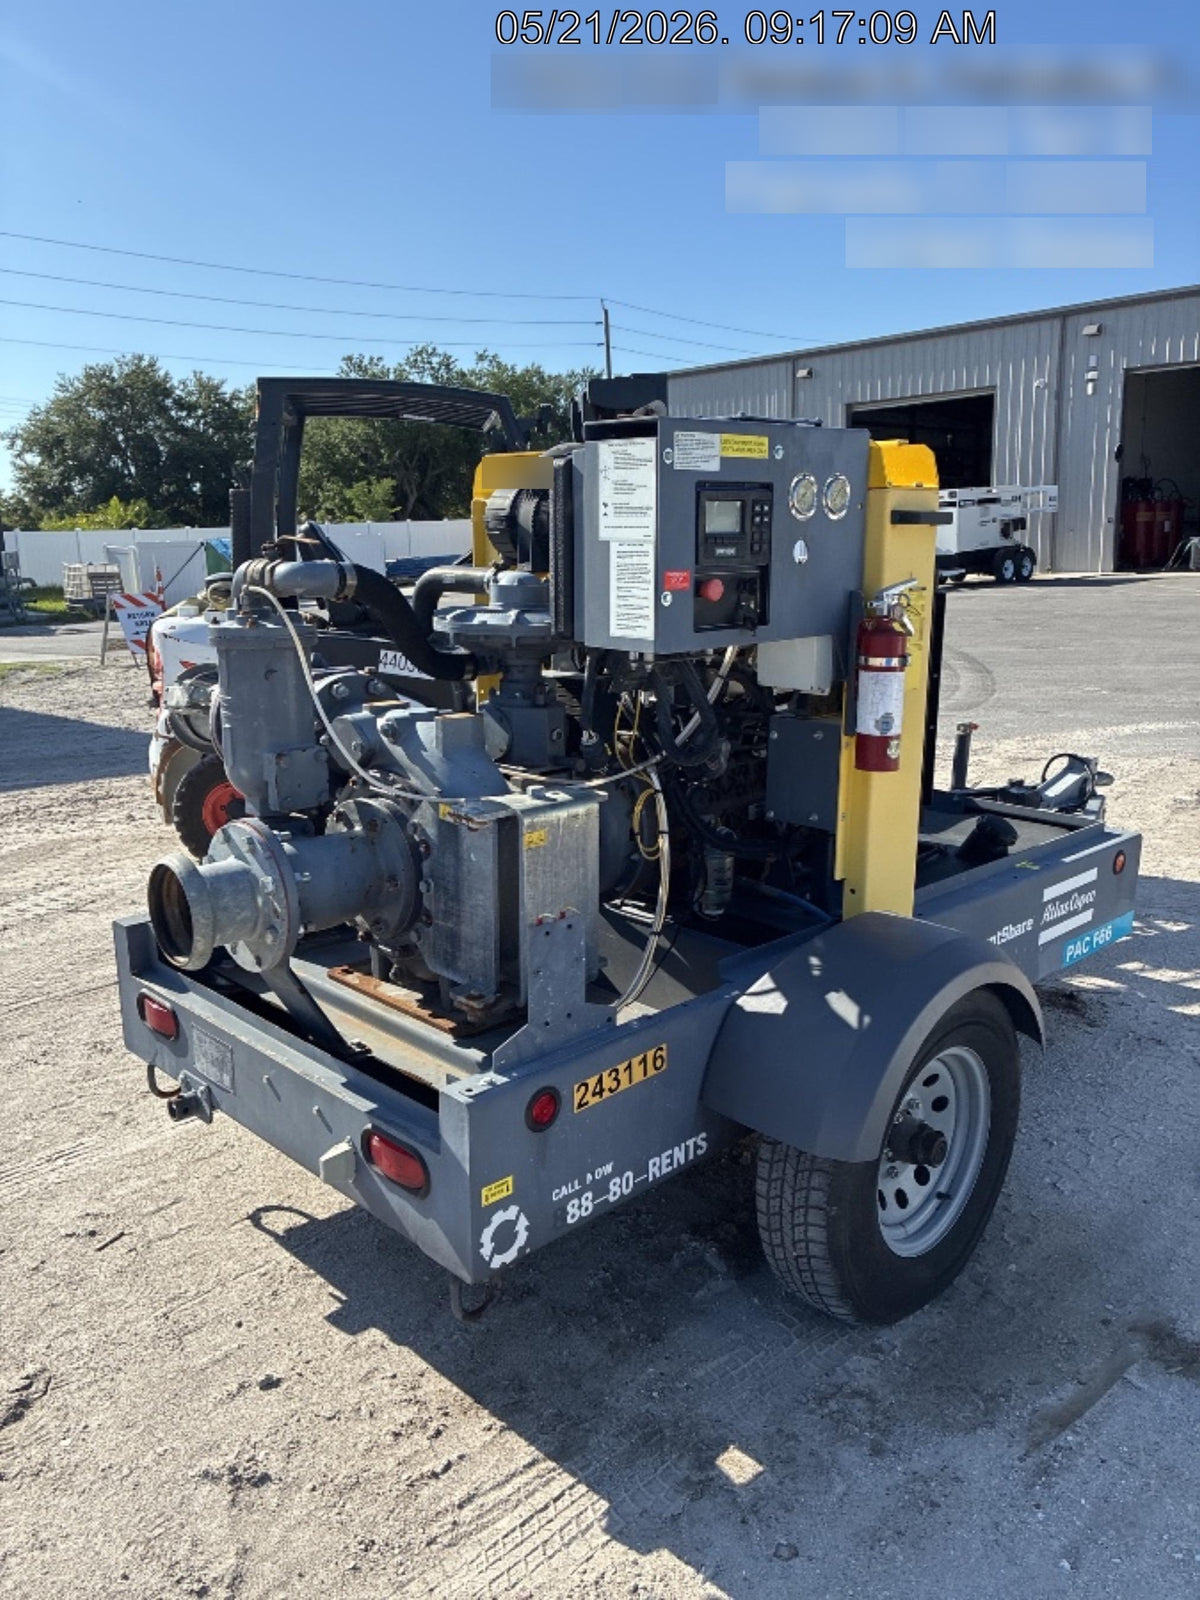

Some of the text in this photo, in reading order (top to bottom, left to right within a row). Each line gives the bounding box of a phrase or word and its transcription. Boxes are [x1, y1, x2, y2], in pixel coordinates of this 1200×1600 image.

[1066, 936, 1091, 963] PAC
[576, 1046, 666, 1110] 243116
[552, 1178, 582, 1201] CALL
